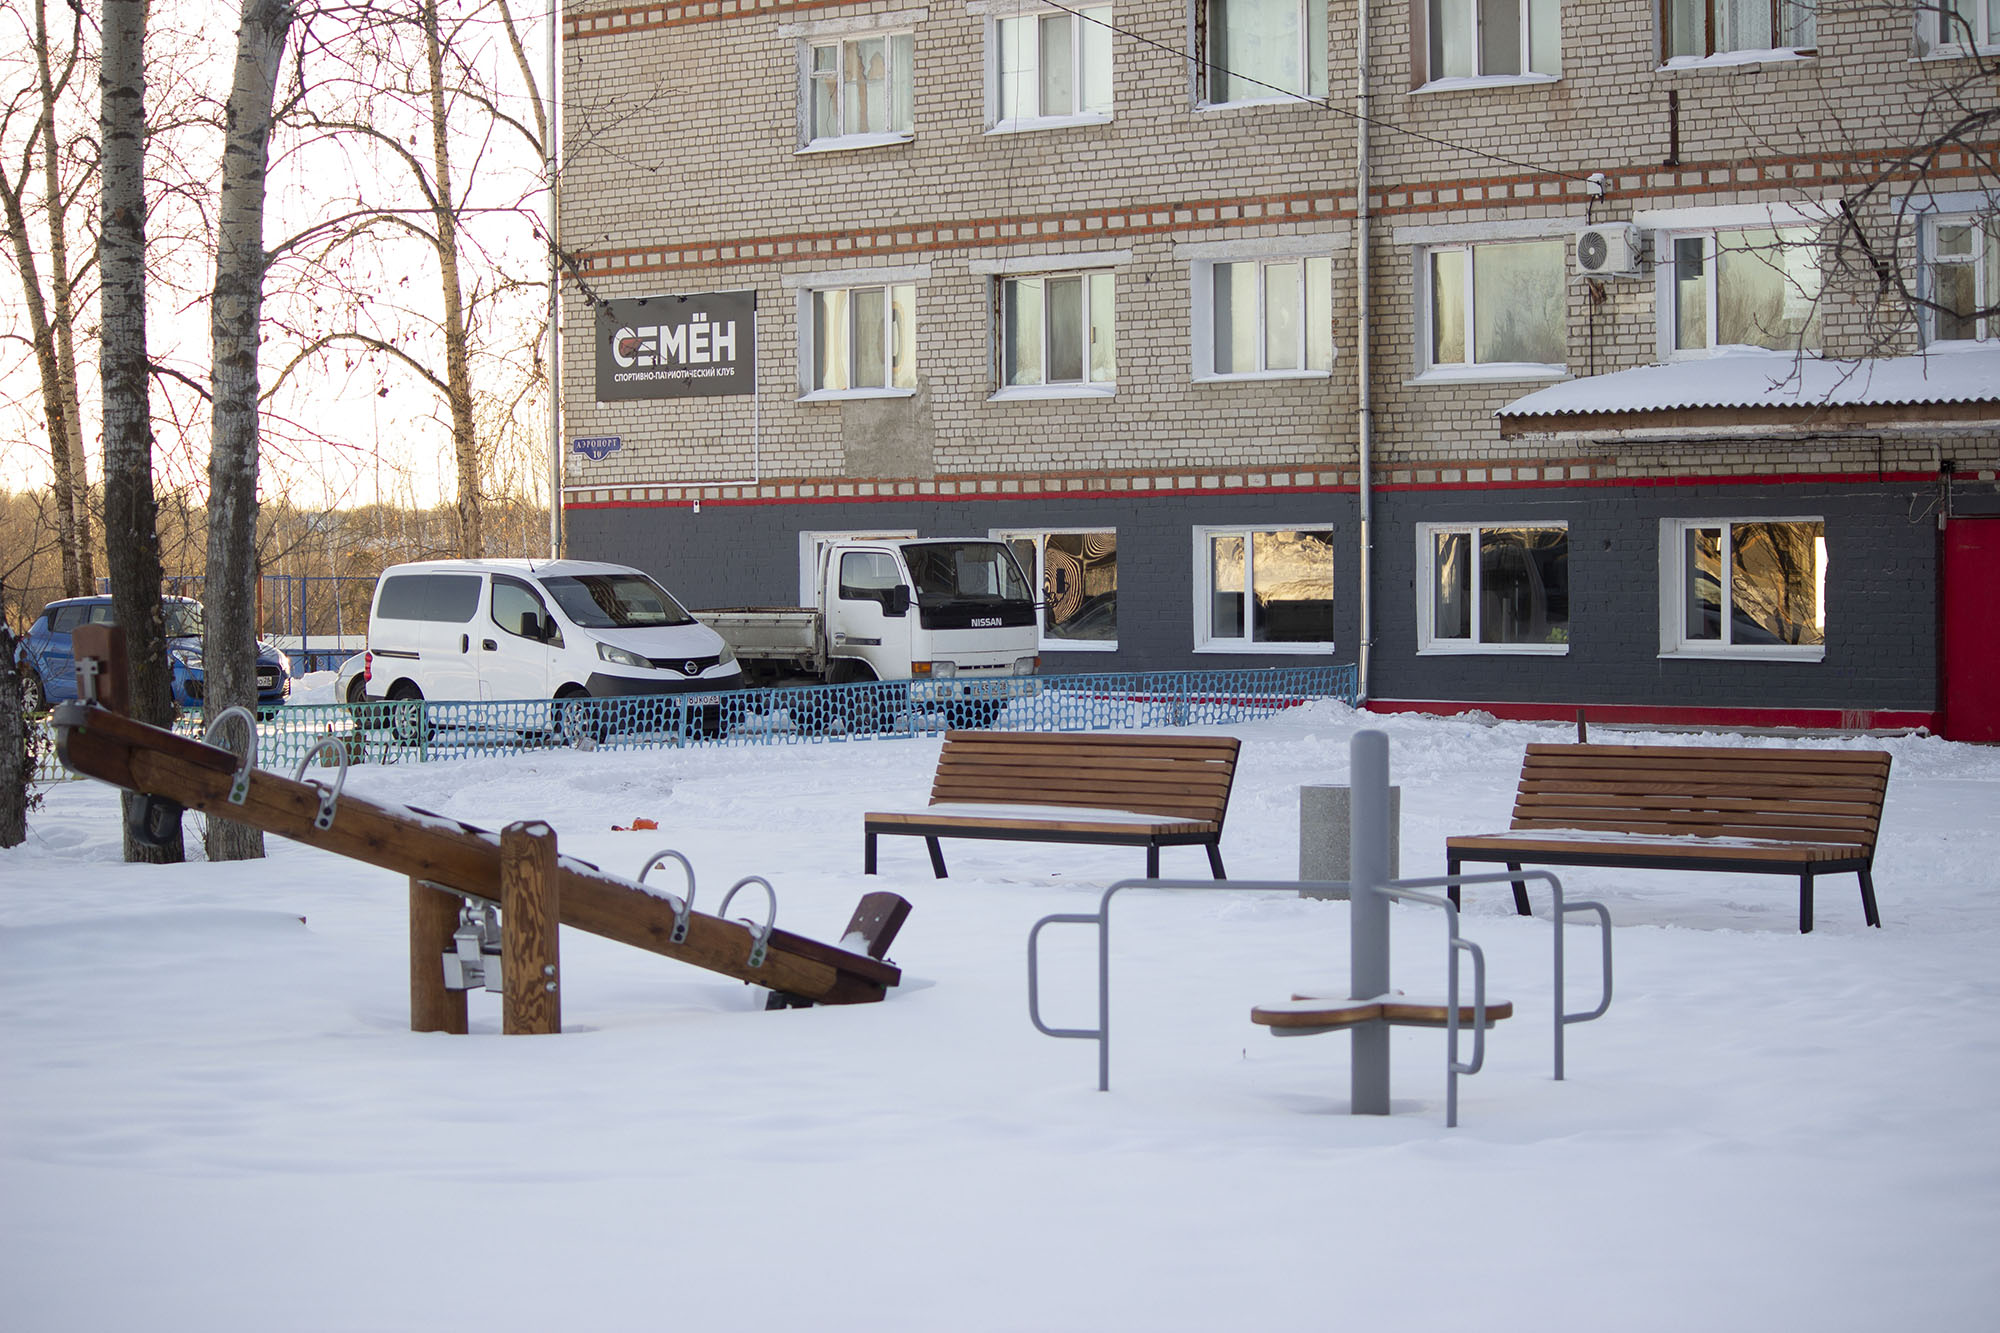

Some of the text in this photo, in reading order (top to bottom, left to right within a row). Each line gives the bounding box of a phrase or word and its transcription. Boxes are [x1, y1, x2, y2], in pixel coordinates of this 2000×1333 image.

[613, 312, 736, 367] СЕМЁН
[614, 367, 735, 382] СПОРТИВНО-ПАТРИОТИЧЕСКИЙ КЛУБ
[577, 439, 617, 449] АЭРОПОРТ
[971, 617, 1002, 627] NISSAN
